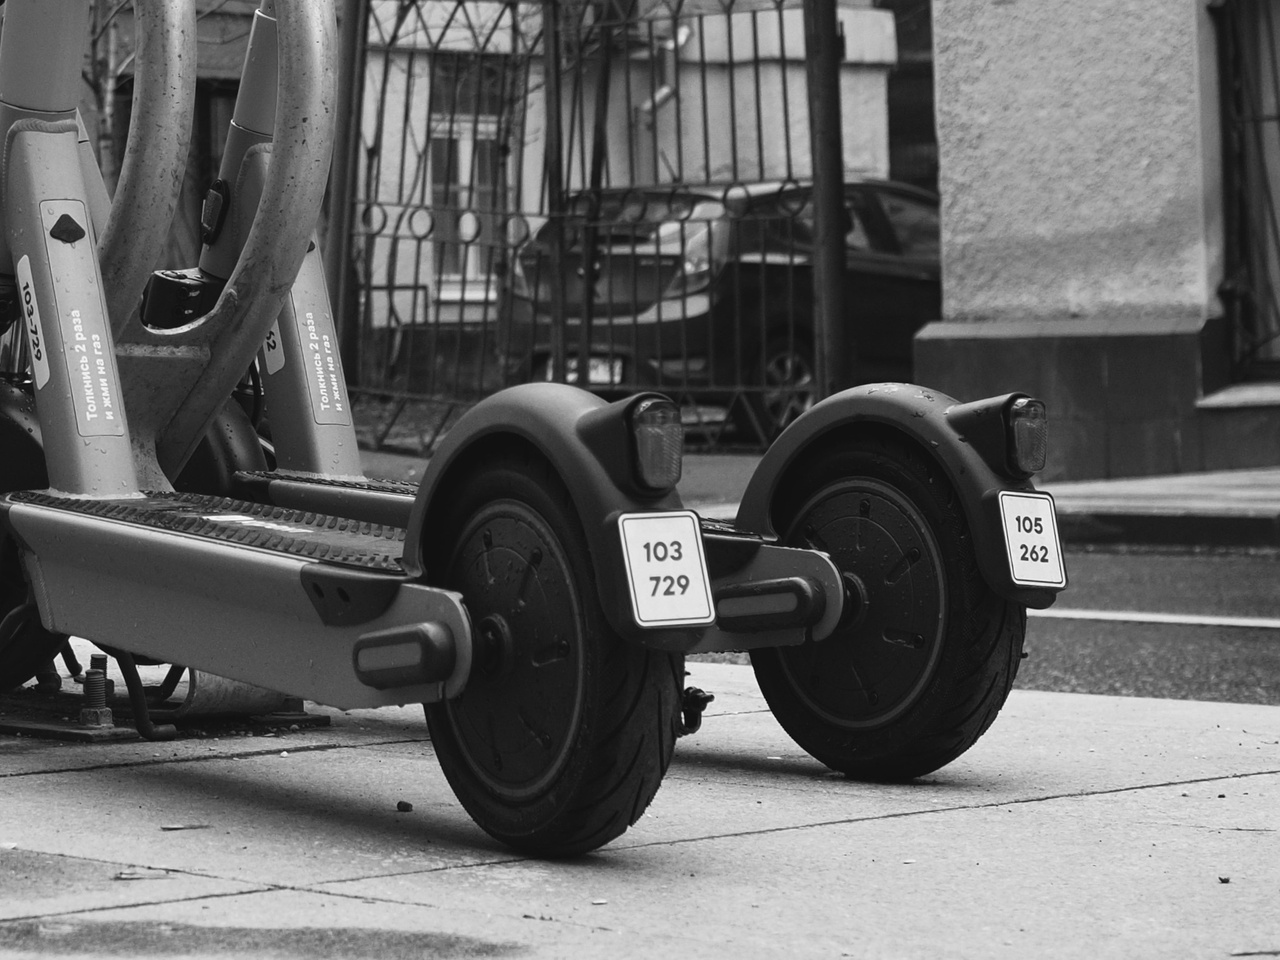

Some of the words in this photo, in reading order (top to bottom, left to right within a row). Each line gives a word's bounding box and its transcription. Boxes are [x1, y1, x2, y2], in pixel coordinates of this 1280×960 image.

[22, 281, 42, 362] 103-729
[71, 309, 87, 341] раза
[306, 312, 319, 340] раза
[75, 343, 87, 353] 2
[91, 334, 103, 355] газ
[309, 342, 319, 350] 2
[322, 334, 332, 354] газ
[96, 359, 106, 375] на
[326, 356, 335, 371] на
[79, 355, 98, 421] Толкнись
[313, 353, 330, 411] Толкнись
[330, 374, 341, 401] жми
[99, 378, 113, 408] жми
[105, 411, 114, 420] и
[335, 403, 343, 411] и
[1015, 515, 1043, 534] 105
[643, 540, 683, 562] 103
[1020, 544, 1049, 563] 262
[649, 574, 690, 597] 729
